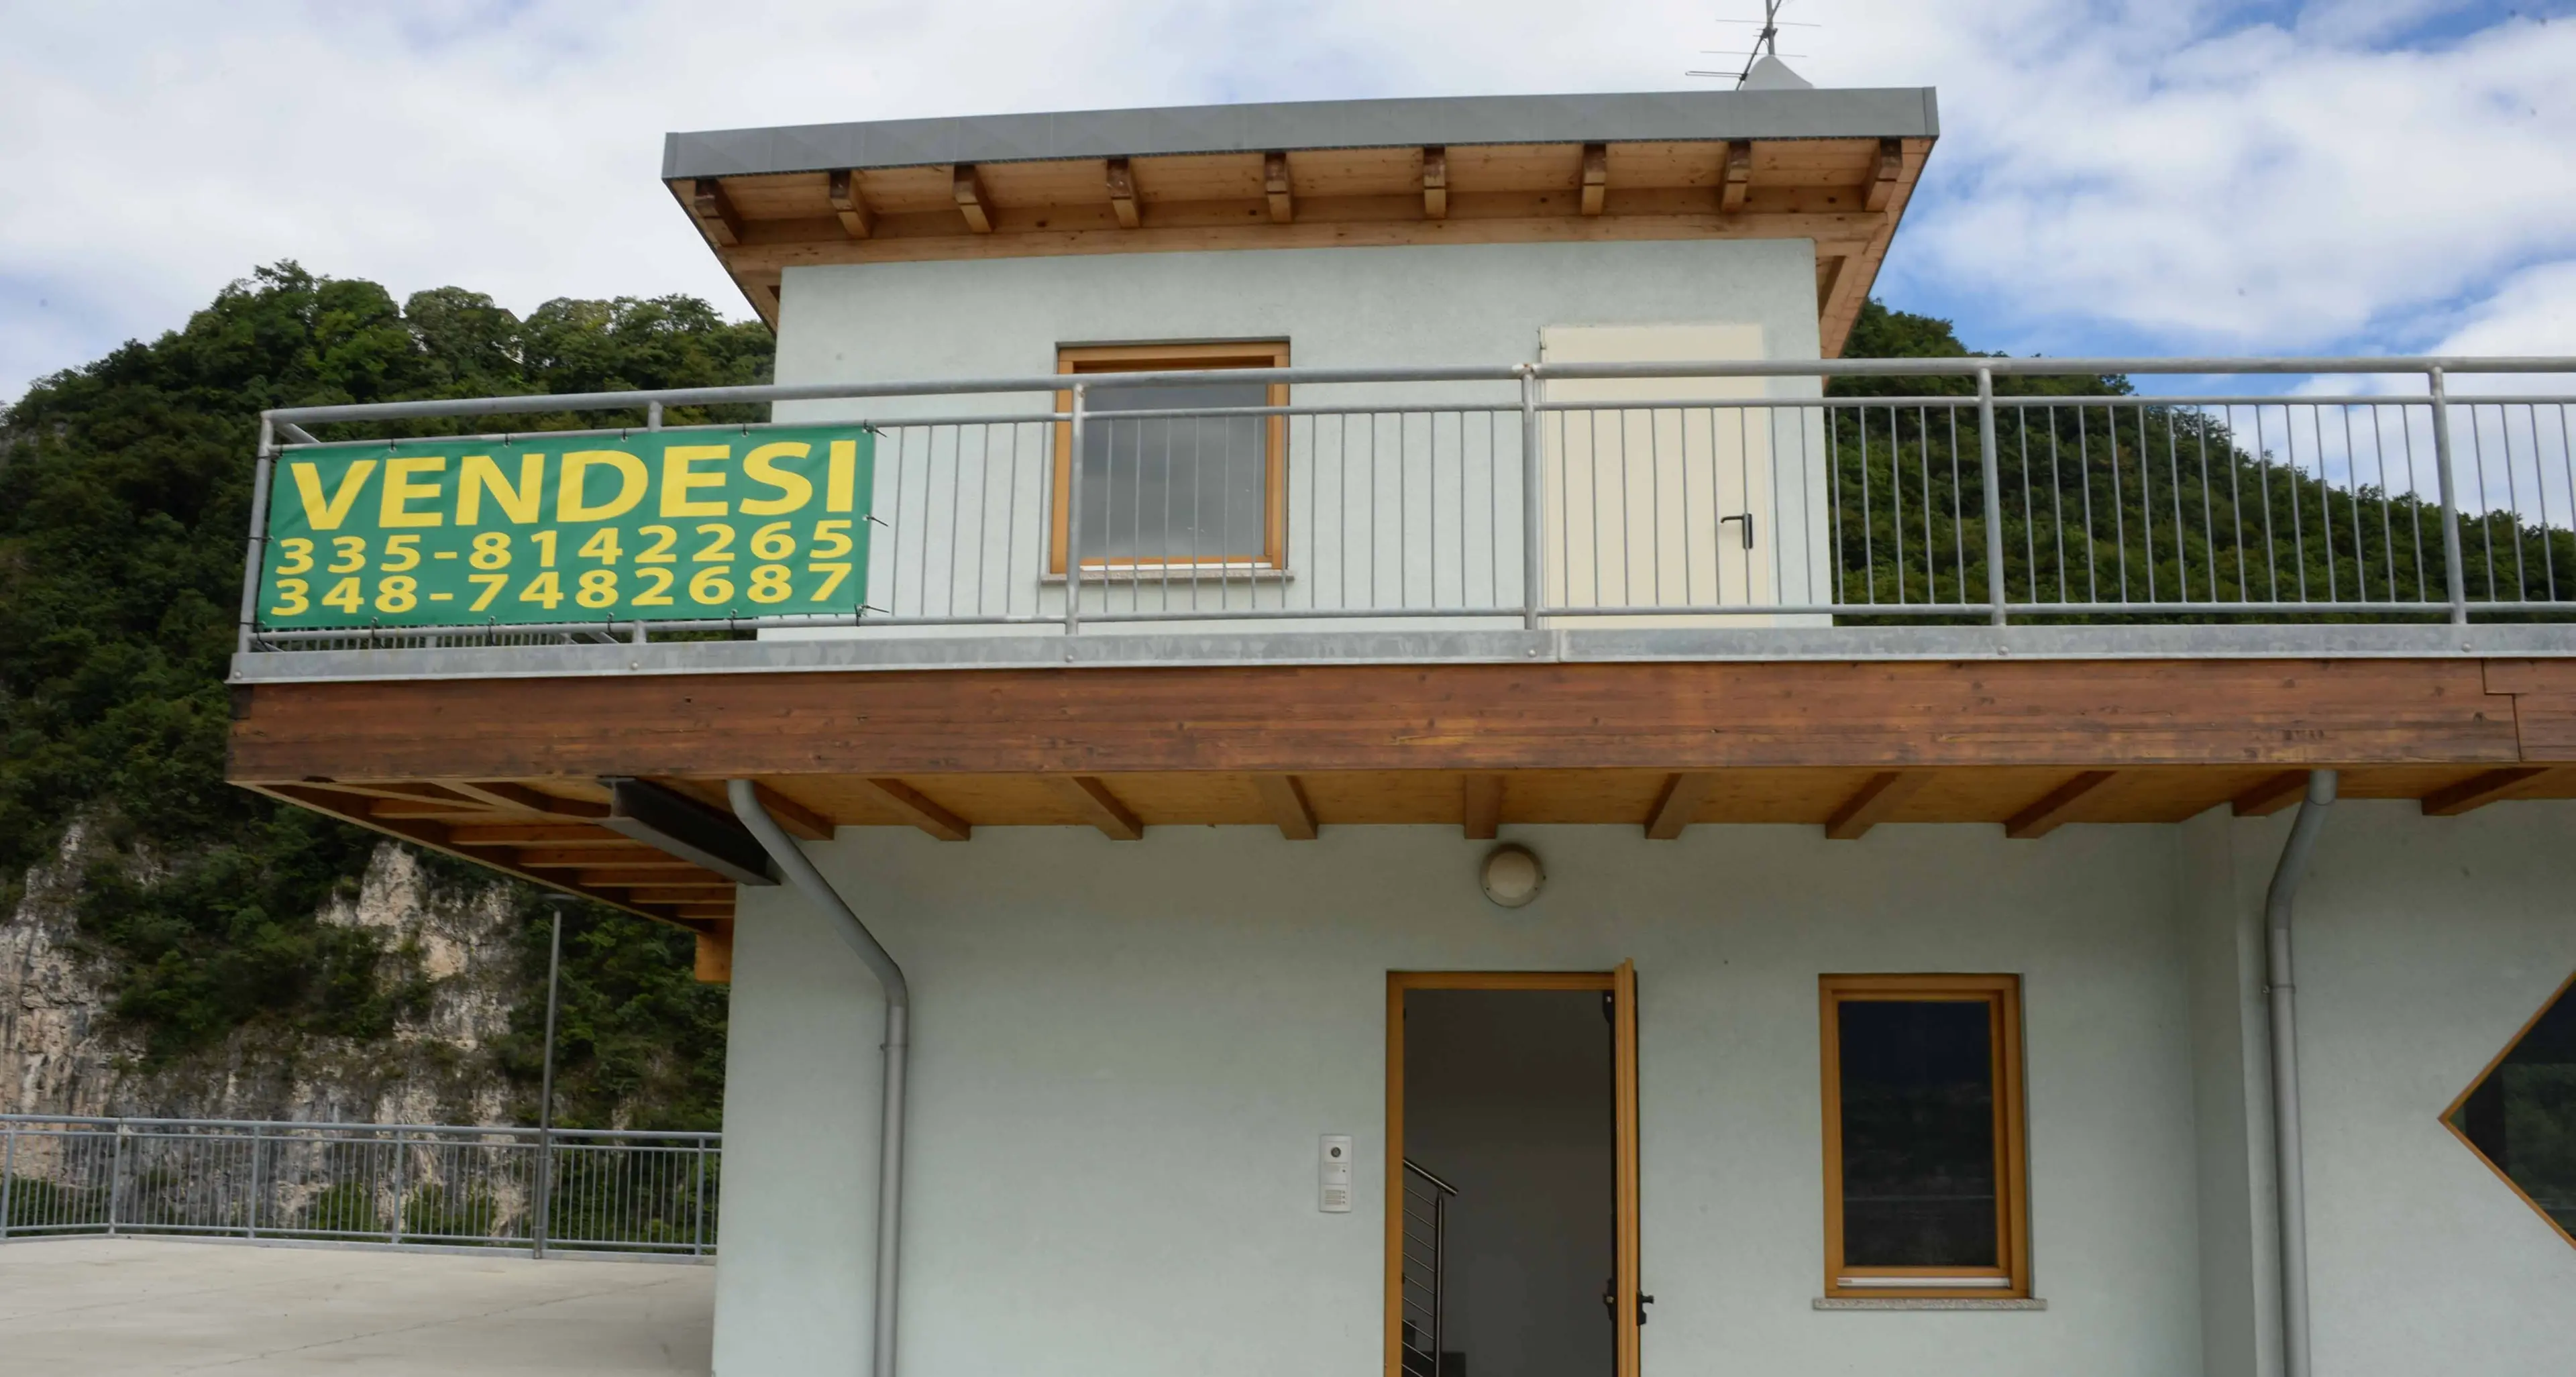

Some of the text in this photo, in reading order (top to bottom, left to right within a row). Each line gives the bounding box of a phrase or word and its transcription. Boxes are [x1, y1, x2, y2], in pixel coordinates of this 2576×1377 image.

[290, 440, 857, 530] VENDESI
[276, 520, 854, 575] 335-8142265
[270, 563, 851, 616] 348-7482687
